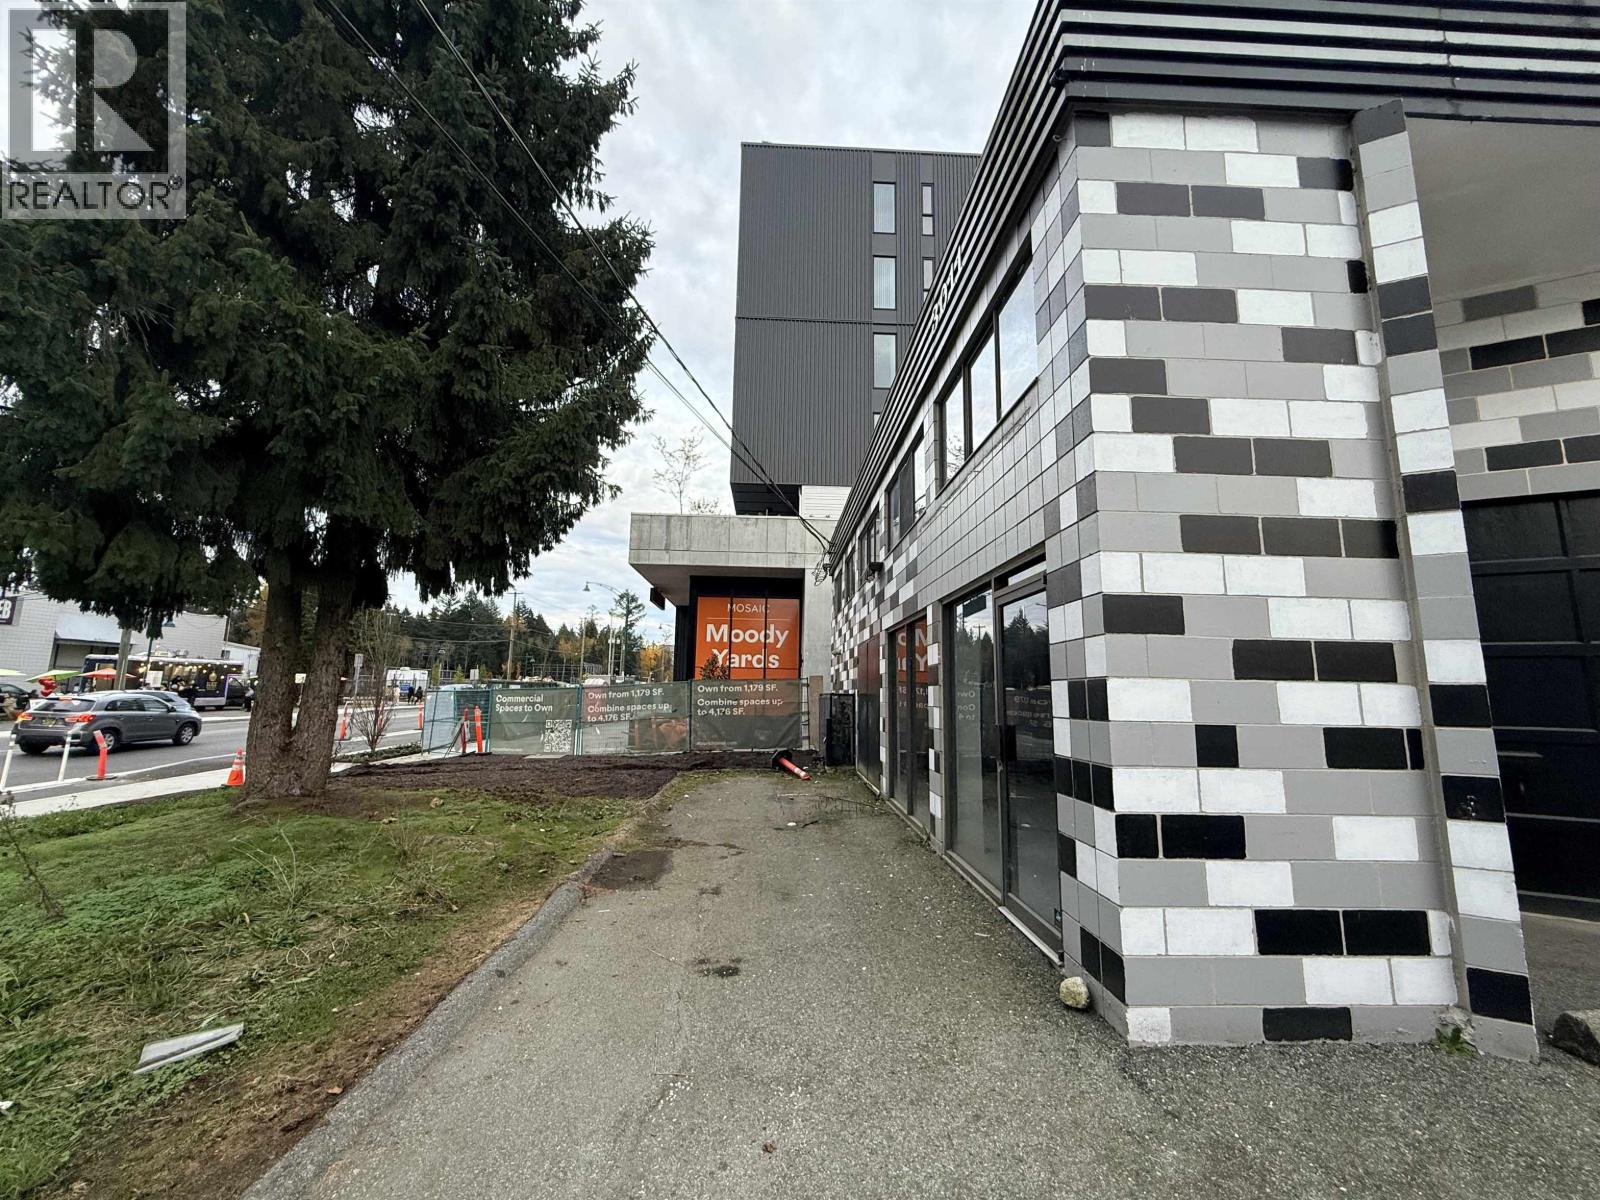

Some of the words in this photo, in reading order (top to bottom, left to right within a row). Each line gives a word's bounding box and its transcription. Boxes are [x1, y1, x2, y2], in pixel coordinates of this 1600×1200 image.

[727, 603, 770, 613] MOSAIC
[706, 623, 789, 649] Moody
[711, 648, 780, 669] Yards
[608, 690, 629, 698] from
[630, 688, 650, 697] 1,179
[652, 687, 665, 696] SF.
[697, 685, 718, 693] Own
[720, 684, 742, 692] from
[744, 684, 764, 692] 1,179
[765, 683, 778, 692] SF.
[496, 694, 544, 703] Commercial
[697, 698, 738, 706] Combine
[739, 698, 770, 707] spaces
[495, 703, 522, 714] Spaces
[524, 704, 533, 712] to
[534, 704, 553, 712] Own
[587, 704, 625, 713] Combine
[626, 703, 657, 712] spaces
[697, 708, 707, 716] to
[732, 707, 745, 716] SF.
[588, 714, 597, 722] to
